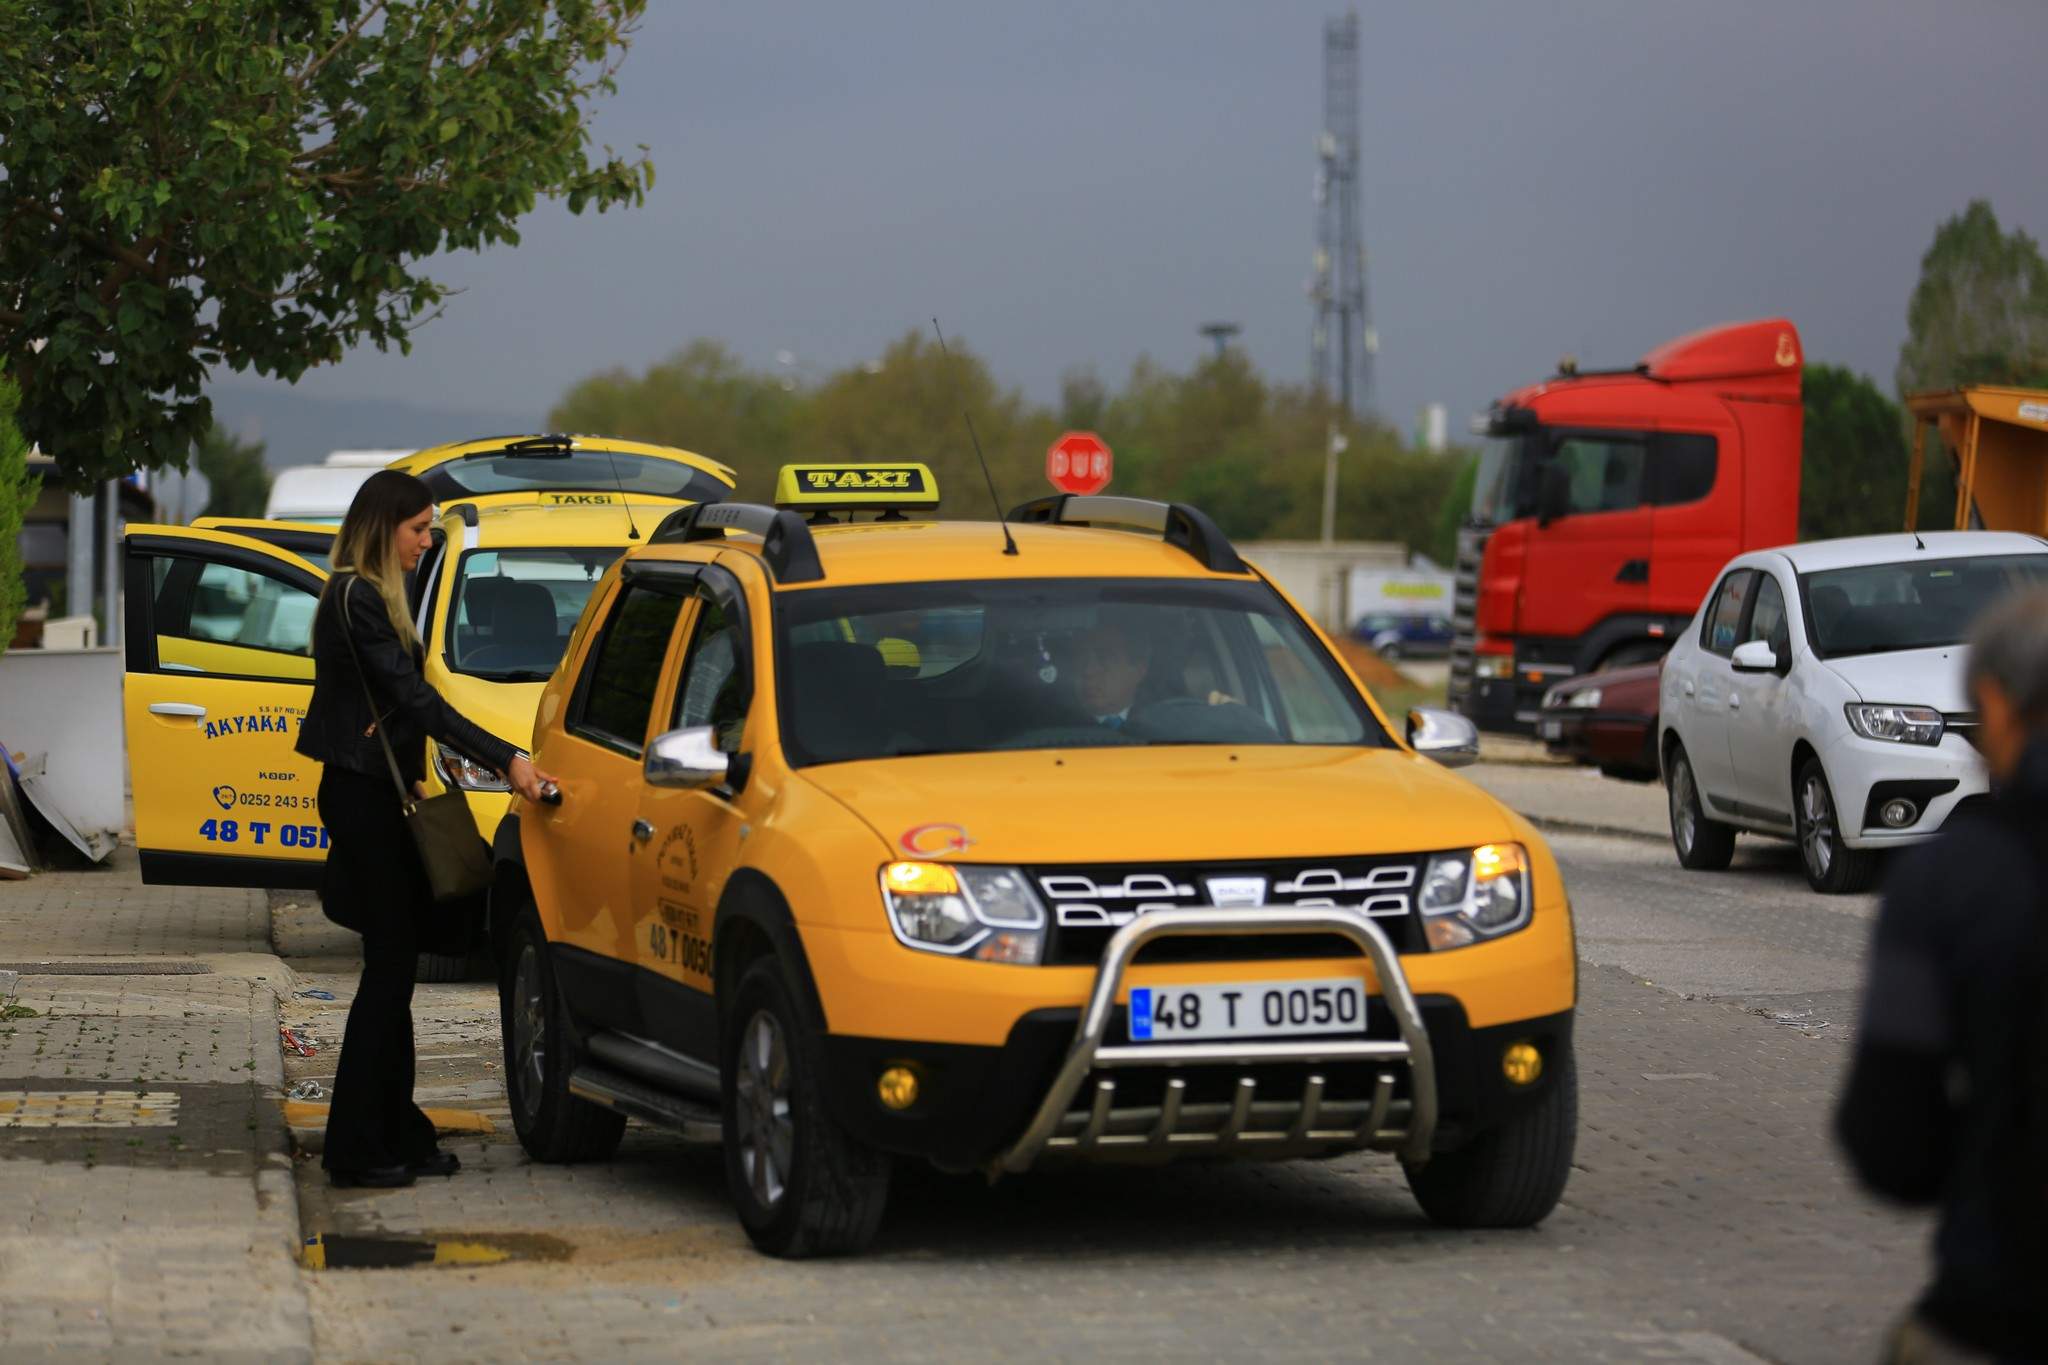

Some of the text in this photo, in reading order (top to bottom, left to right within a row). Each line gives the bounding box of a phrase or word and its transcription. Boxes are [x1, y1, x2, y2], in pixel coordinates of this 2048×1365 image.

[1051, 448, 1109, 479] DUR
[807, 471, 911, 488] TAXI
[204, 714, 288, 740] AKYAKA
[239, 793, 316, 809] 0252 243 51
[199, 818, 239, 843] 48
[249, 821, 271, 845] T
[650, 922, 667, 960] 48
[670, 927, 679, 964] T
[1154, 986, 1358, 1030] 48 T 0050
